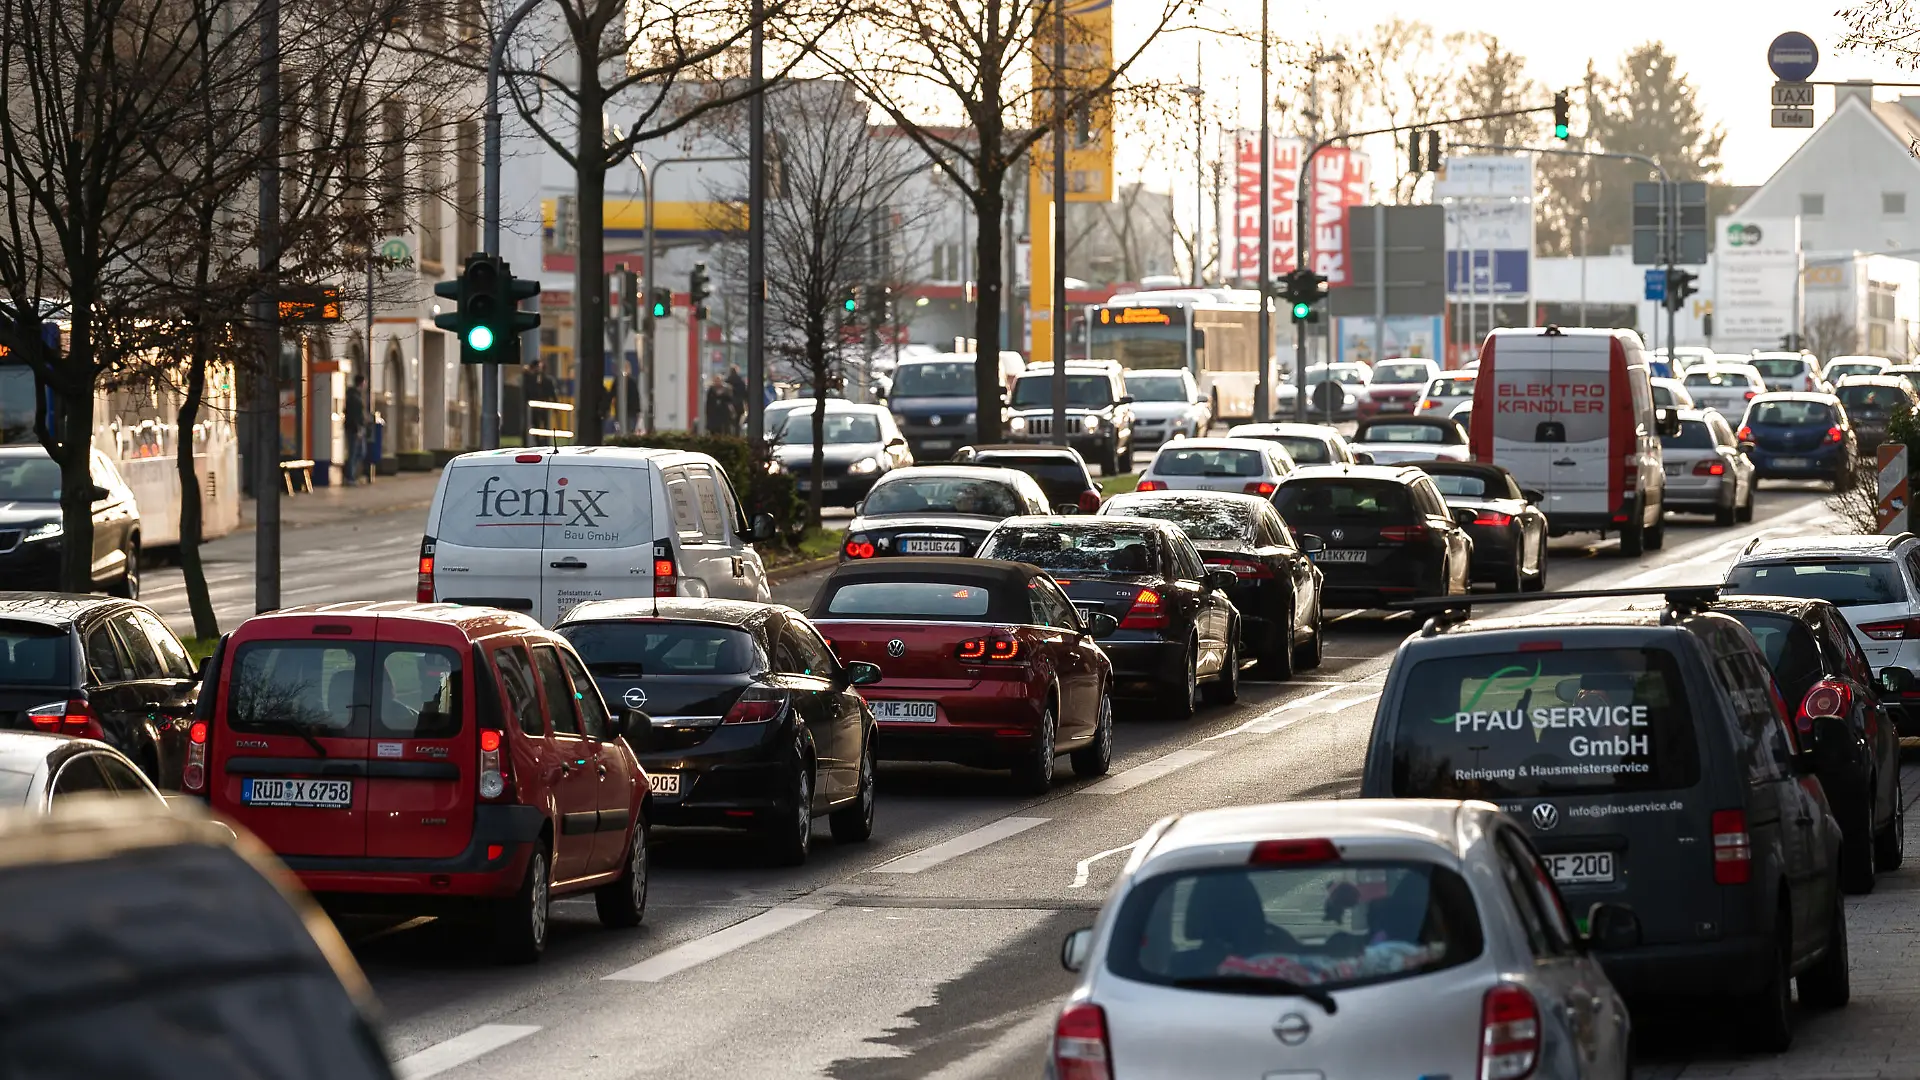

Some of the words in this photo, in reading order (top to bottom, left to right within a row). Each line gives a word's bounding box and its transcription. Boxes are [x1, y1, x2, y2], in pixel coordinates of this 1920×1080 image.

[1777, 89, 1811, 102] TAXI
[1272, 137, 1297, 276] REWE
[1315, 153, 1346, 283] REWE
[1498, 383, 1605, 398] ELEKTRO
[1498, 401, 1605, 414] KANDLER
[564, 529, 584, 540] Bau
[587, 531, 620, 542] GmbH
[911, 541, 923, 551] WI
[929, 541, 942, 551] UG
[944, 541, 956, 551] 44
[1333, 551, 1345, 560] KK
[1347, 551, 1365, 560] 777
[884, 702, 901, 716] NE
[903, 703, 934, 717] 1000
[1455, 709, 1523, 732] PFAU
[1532, 705, 1648, 729] SERVICE
[236, 739, 268, 748] DACIA
[415, 746, 449, 754] LOGAN
[1569, 735, 1648, 757] GmbH
[1455, 767, 1516, 781] Reinigung
[1518, 765, 1527, 776] &
[1530, 762, 1649, 776] Hausmeisterservice
[253, 781, 283, 799] RÜD
[295, 782, 305, 800] X
[308, 782, 349, 801] 6758
[1568, 801, 1683, 817] info@pfau-service.de
[1571, 855, 1610, 876] 200
